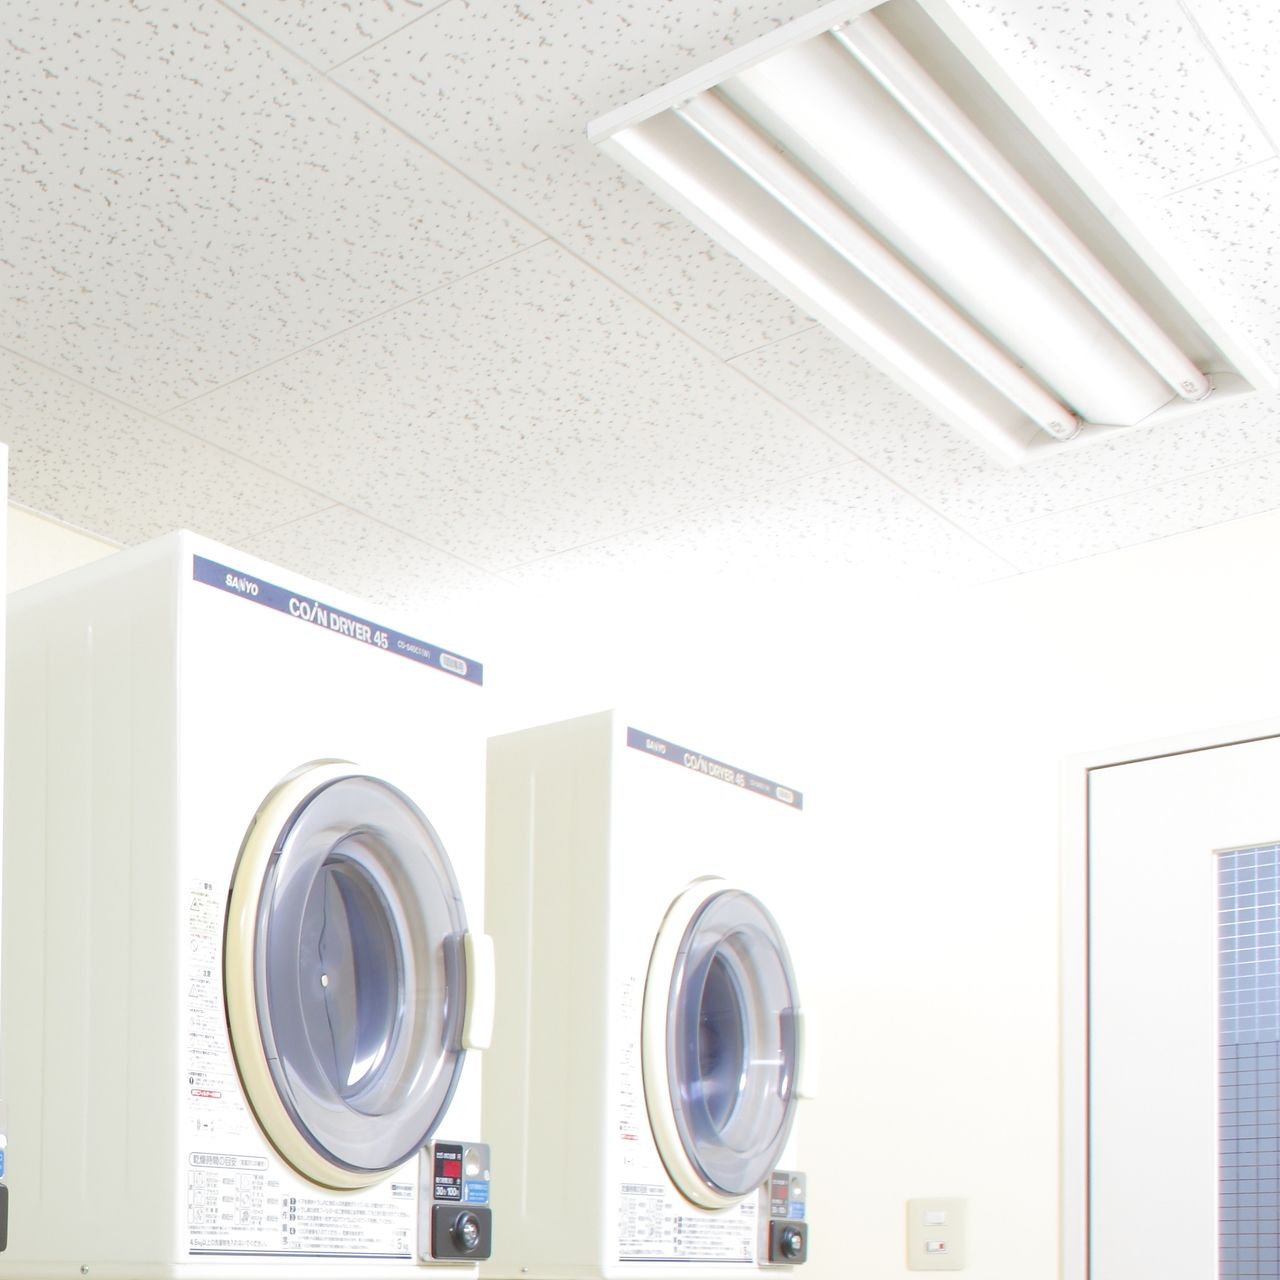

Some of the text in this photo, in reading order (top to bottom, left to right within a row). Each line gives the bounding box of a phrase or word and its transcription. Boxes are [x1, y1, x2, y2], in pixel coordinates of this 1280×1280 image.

[225, 574, 259, 596] SANYO
[330, 614, 372, 643] DRYER
[373, 630, 388, 649] 45
